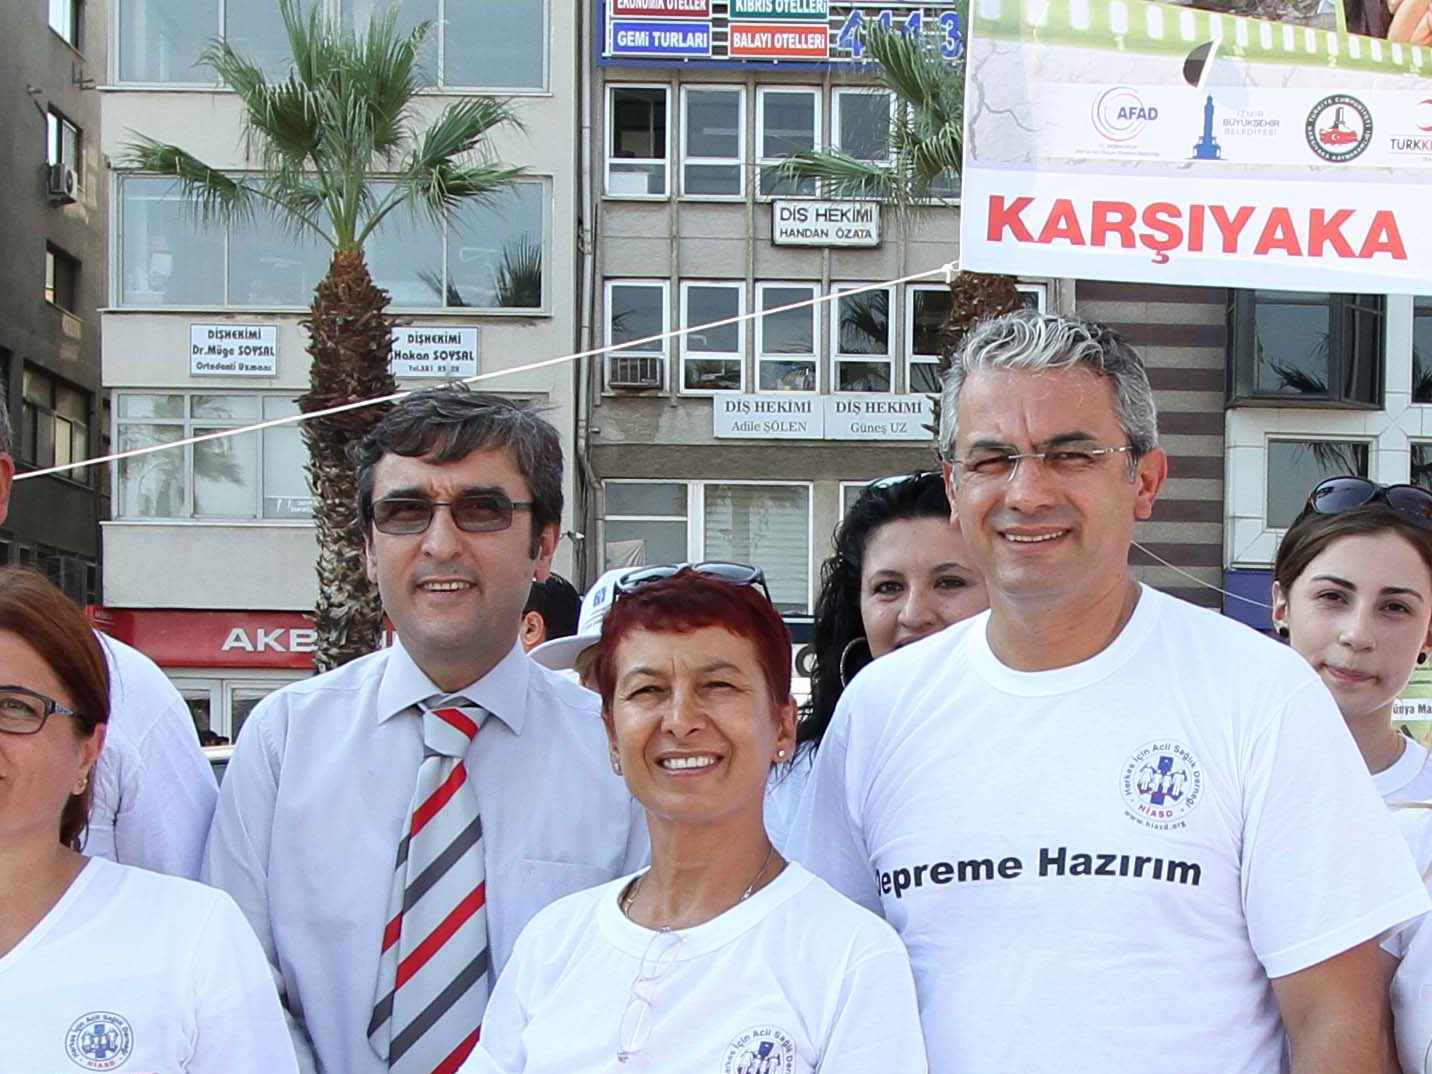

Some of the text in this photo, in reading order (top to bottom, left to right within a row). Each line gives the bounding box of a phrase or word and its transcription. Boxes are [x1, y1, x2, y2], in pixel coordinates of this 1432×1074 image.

[617, 30, 708, 48] GEMİ TURLARI
[732, 32, 826, 49] BALAYI OTELLERİ
[1116, 106, 1159, 121] AFAD
[815, 203, 873, 223] HEKİMİ
[779, 227, 873, 239] HANDAN ÖZATA
[985, 194, 1407, 265] KARŞIYAKA
[237, 345, 275, 357] SOYSAL
[393, 349, 475, 361] Hakan SOYSAL
[725, 399, 812, 416] DİŞ HEKİMİ
[835, 399, 923, 416] DİŞ HEKİMİ
[731, 421, 761, 433] Adile
[850, 422, 908, 435] Güneş UZ
[1037, 847, 1202, 887] Hazırım
